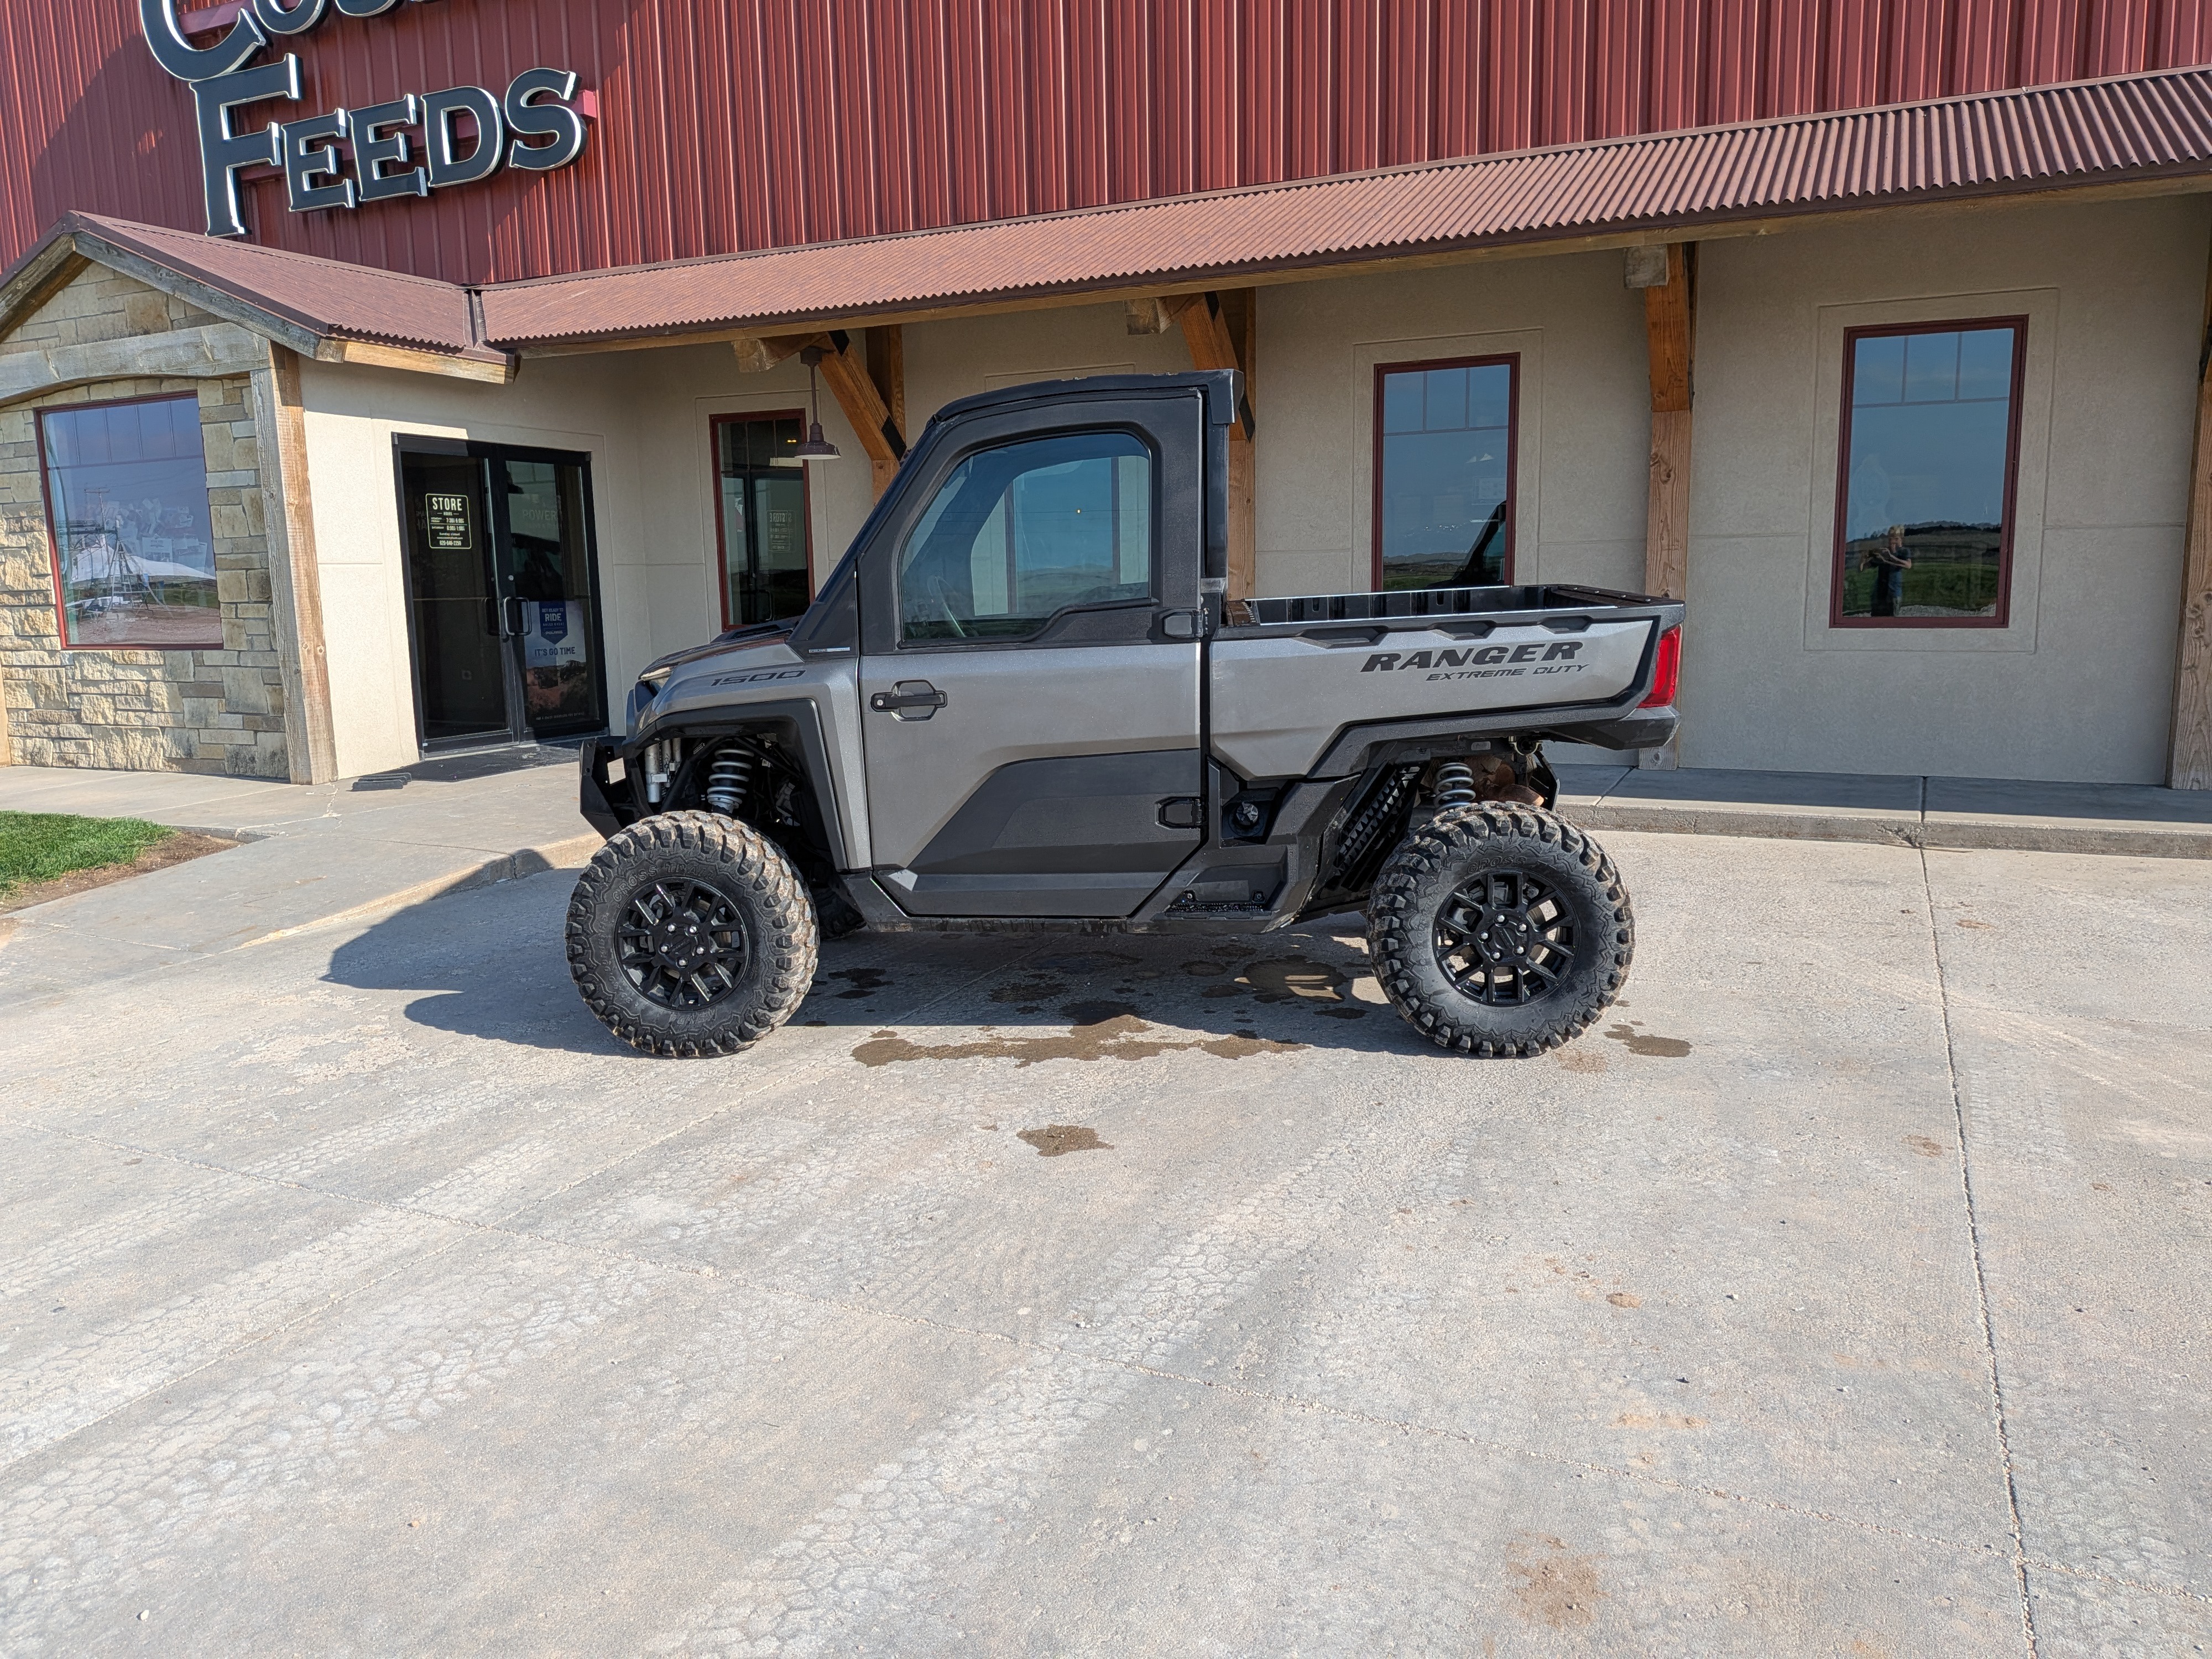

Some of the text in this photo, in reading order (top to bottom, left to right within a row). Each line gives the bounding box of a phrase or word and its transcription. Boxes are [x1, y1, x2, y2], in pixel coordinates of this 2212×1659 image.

[189, 53, 585, 237] FEEDS
[432, 497, 462, 511] STORE
[545, 613, 562, 622] RIDE
[559, 646, 576, 655] TIME
[1360, 641, 1584, 673] RANGER
[711, 670, 806, 687] 1500
[1425, 664, 1589, 682] EXTREME DUTY
[1467, 855, 1526, 873] CROSS
[612, 863, 714, 902] CROSS TRAIL
